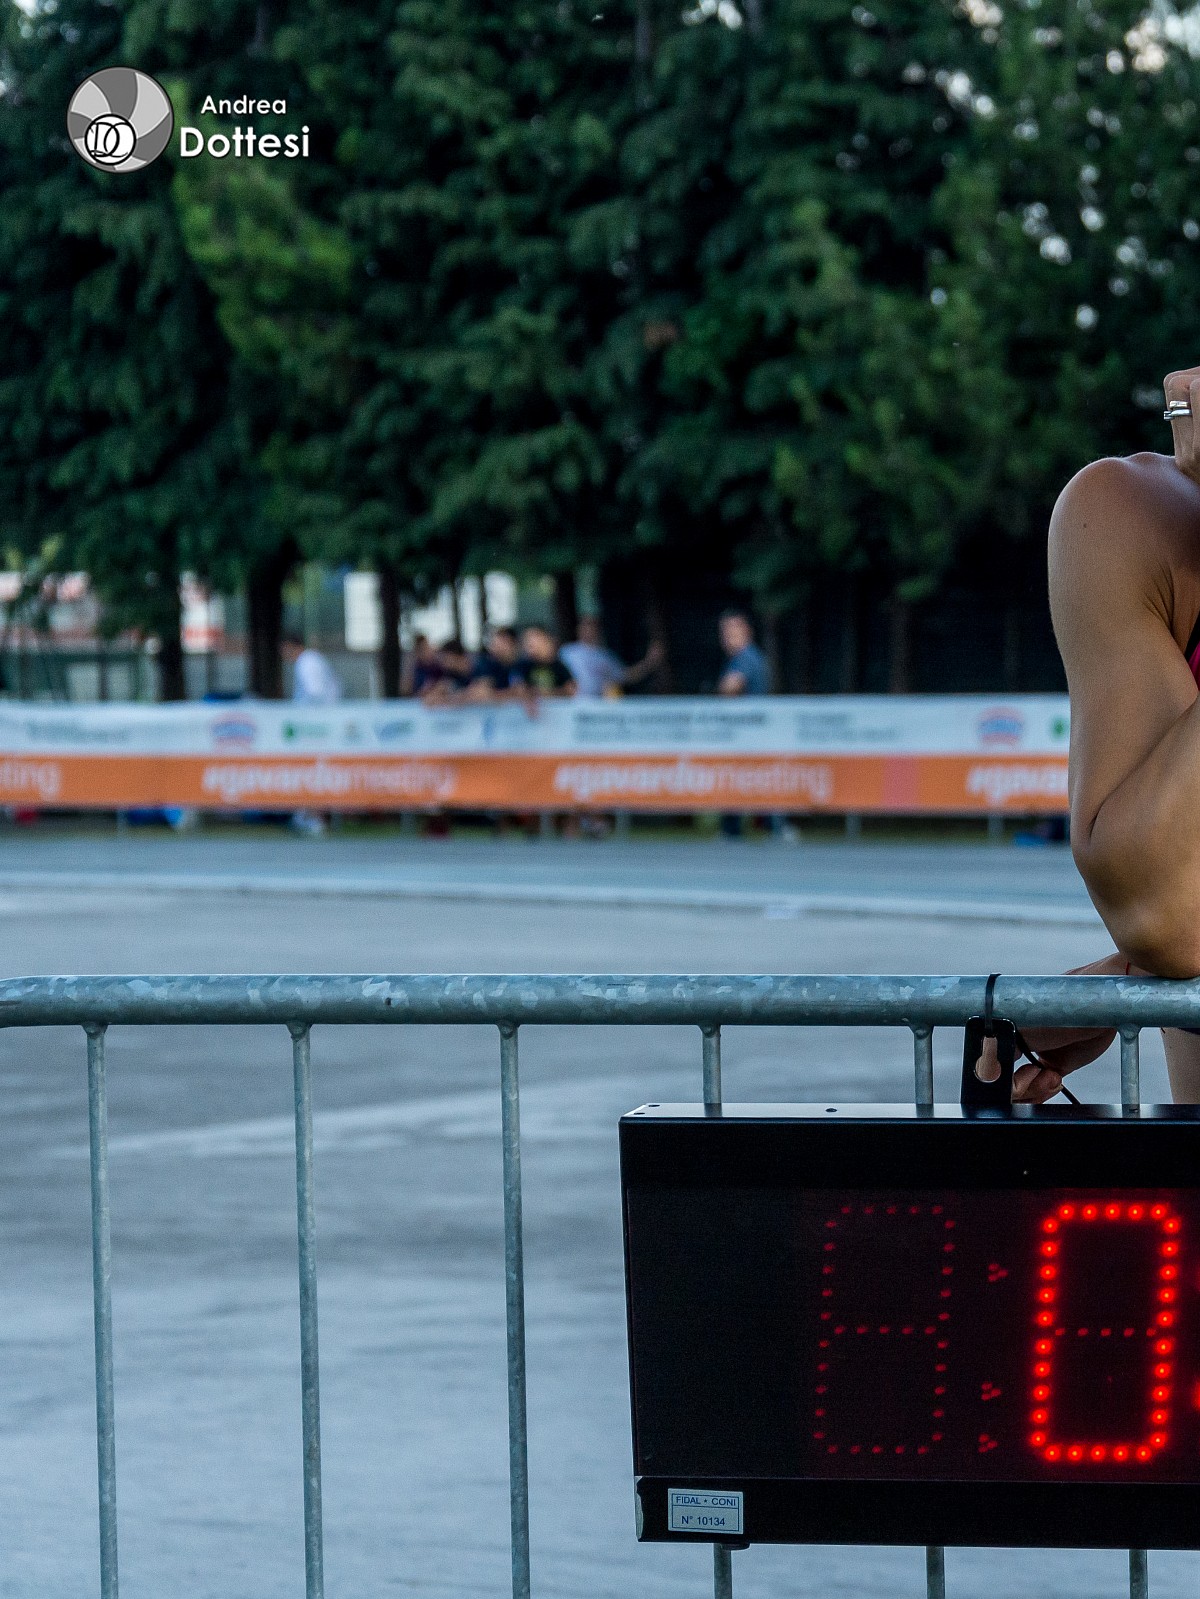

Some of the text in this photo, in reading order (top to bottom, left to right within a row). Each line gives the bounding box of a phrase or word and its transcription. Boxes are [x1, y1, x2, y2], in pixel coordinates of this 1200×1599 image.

[676, 1496, 736, 1507] FIDAL CONI
[681, 1515, 726, 1526] N° 10134
